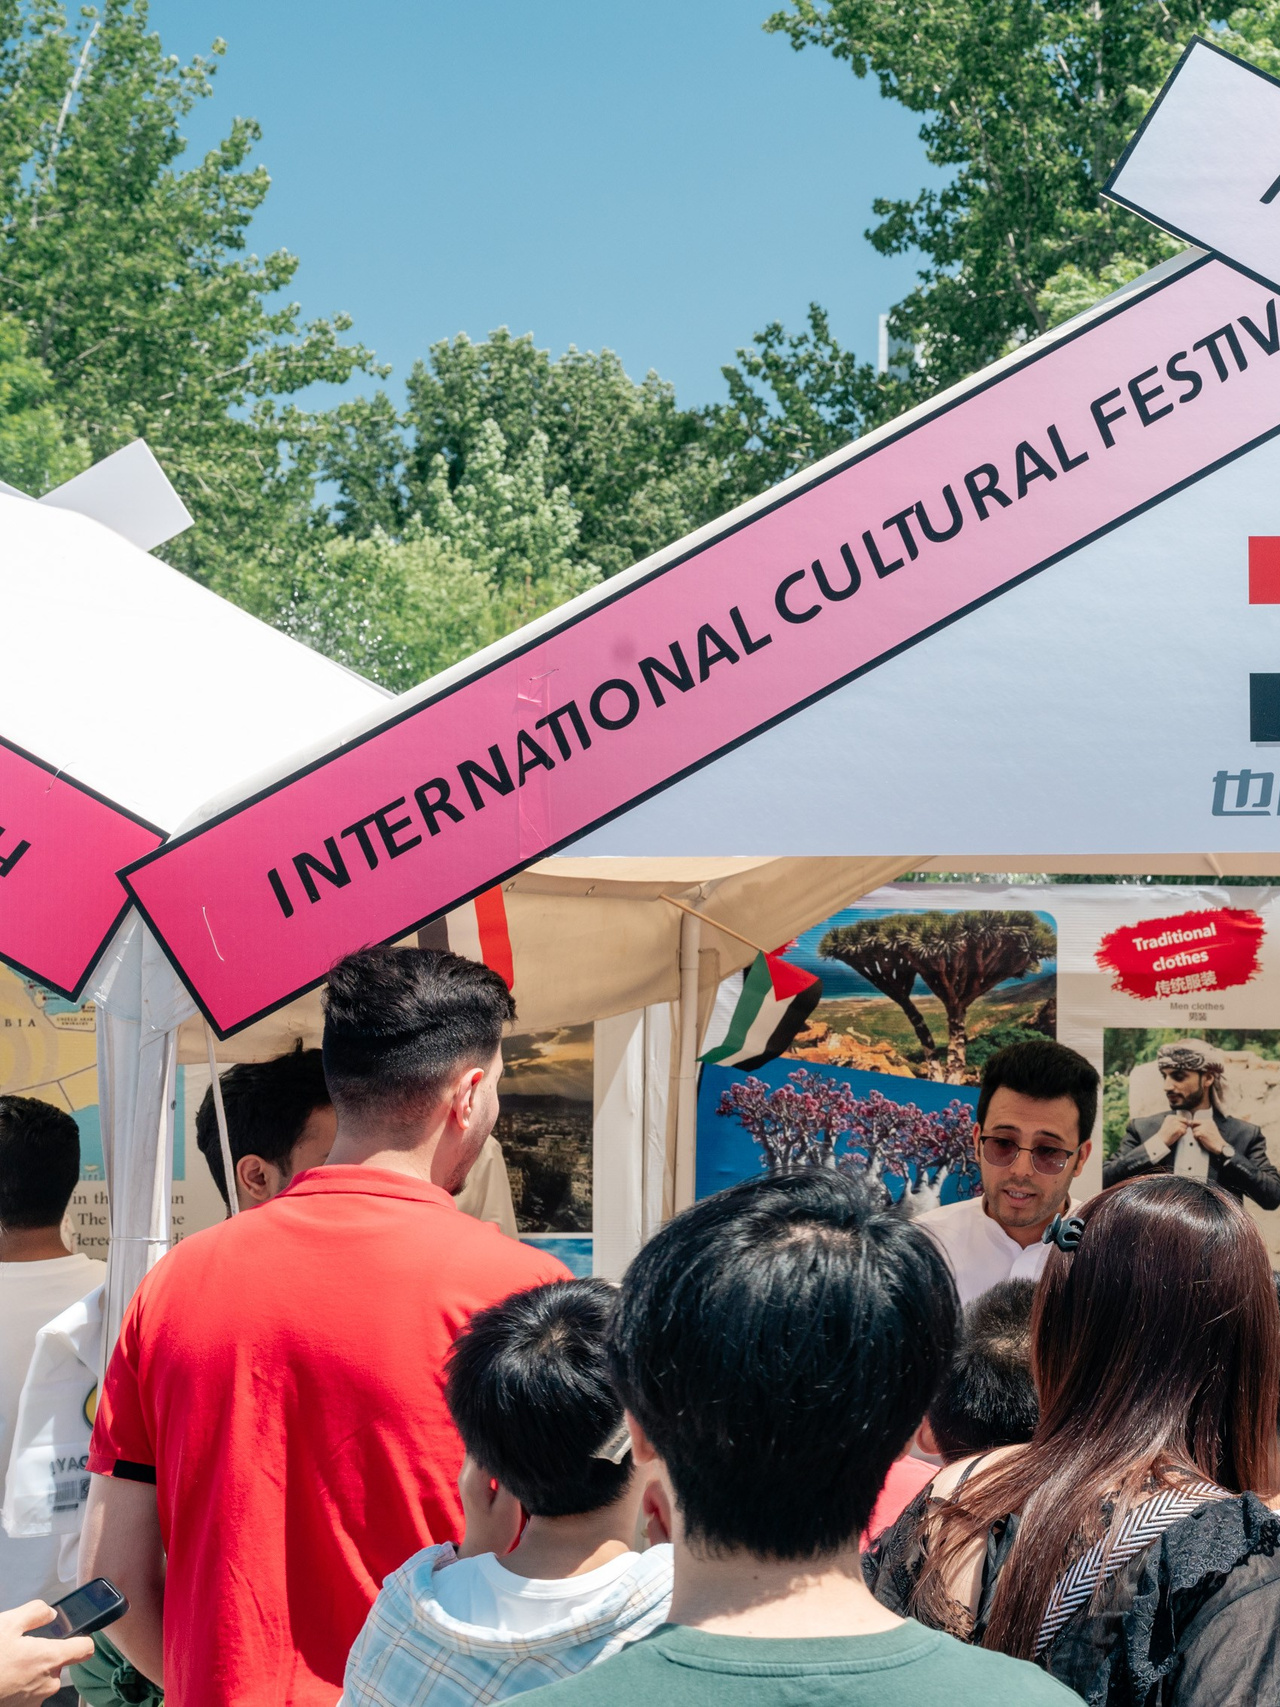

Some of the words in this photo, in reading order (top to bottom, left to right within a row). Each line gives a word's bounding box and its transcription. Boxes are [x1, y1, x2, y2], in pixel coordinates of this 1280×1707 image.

[267, 605, 773, 919] INTERNATIONAL
[774, 423, 1090, 624] CULTURAL
[1132, 922, 1217, 951] Traditional
[1152, 951, 1209, 972] clothes
[1155, 970, 1217, 996] 传统服装
[1170, 1002, 1189, 1011] Men
[1191, 1002, 1225, 1011] clothes
[73, 1191, 87, 1204] in
[77, 1212, 107, 1225] The
